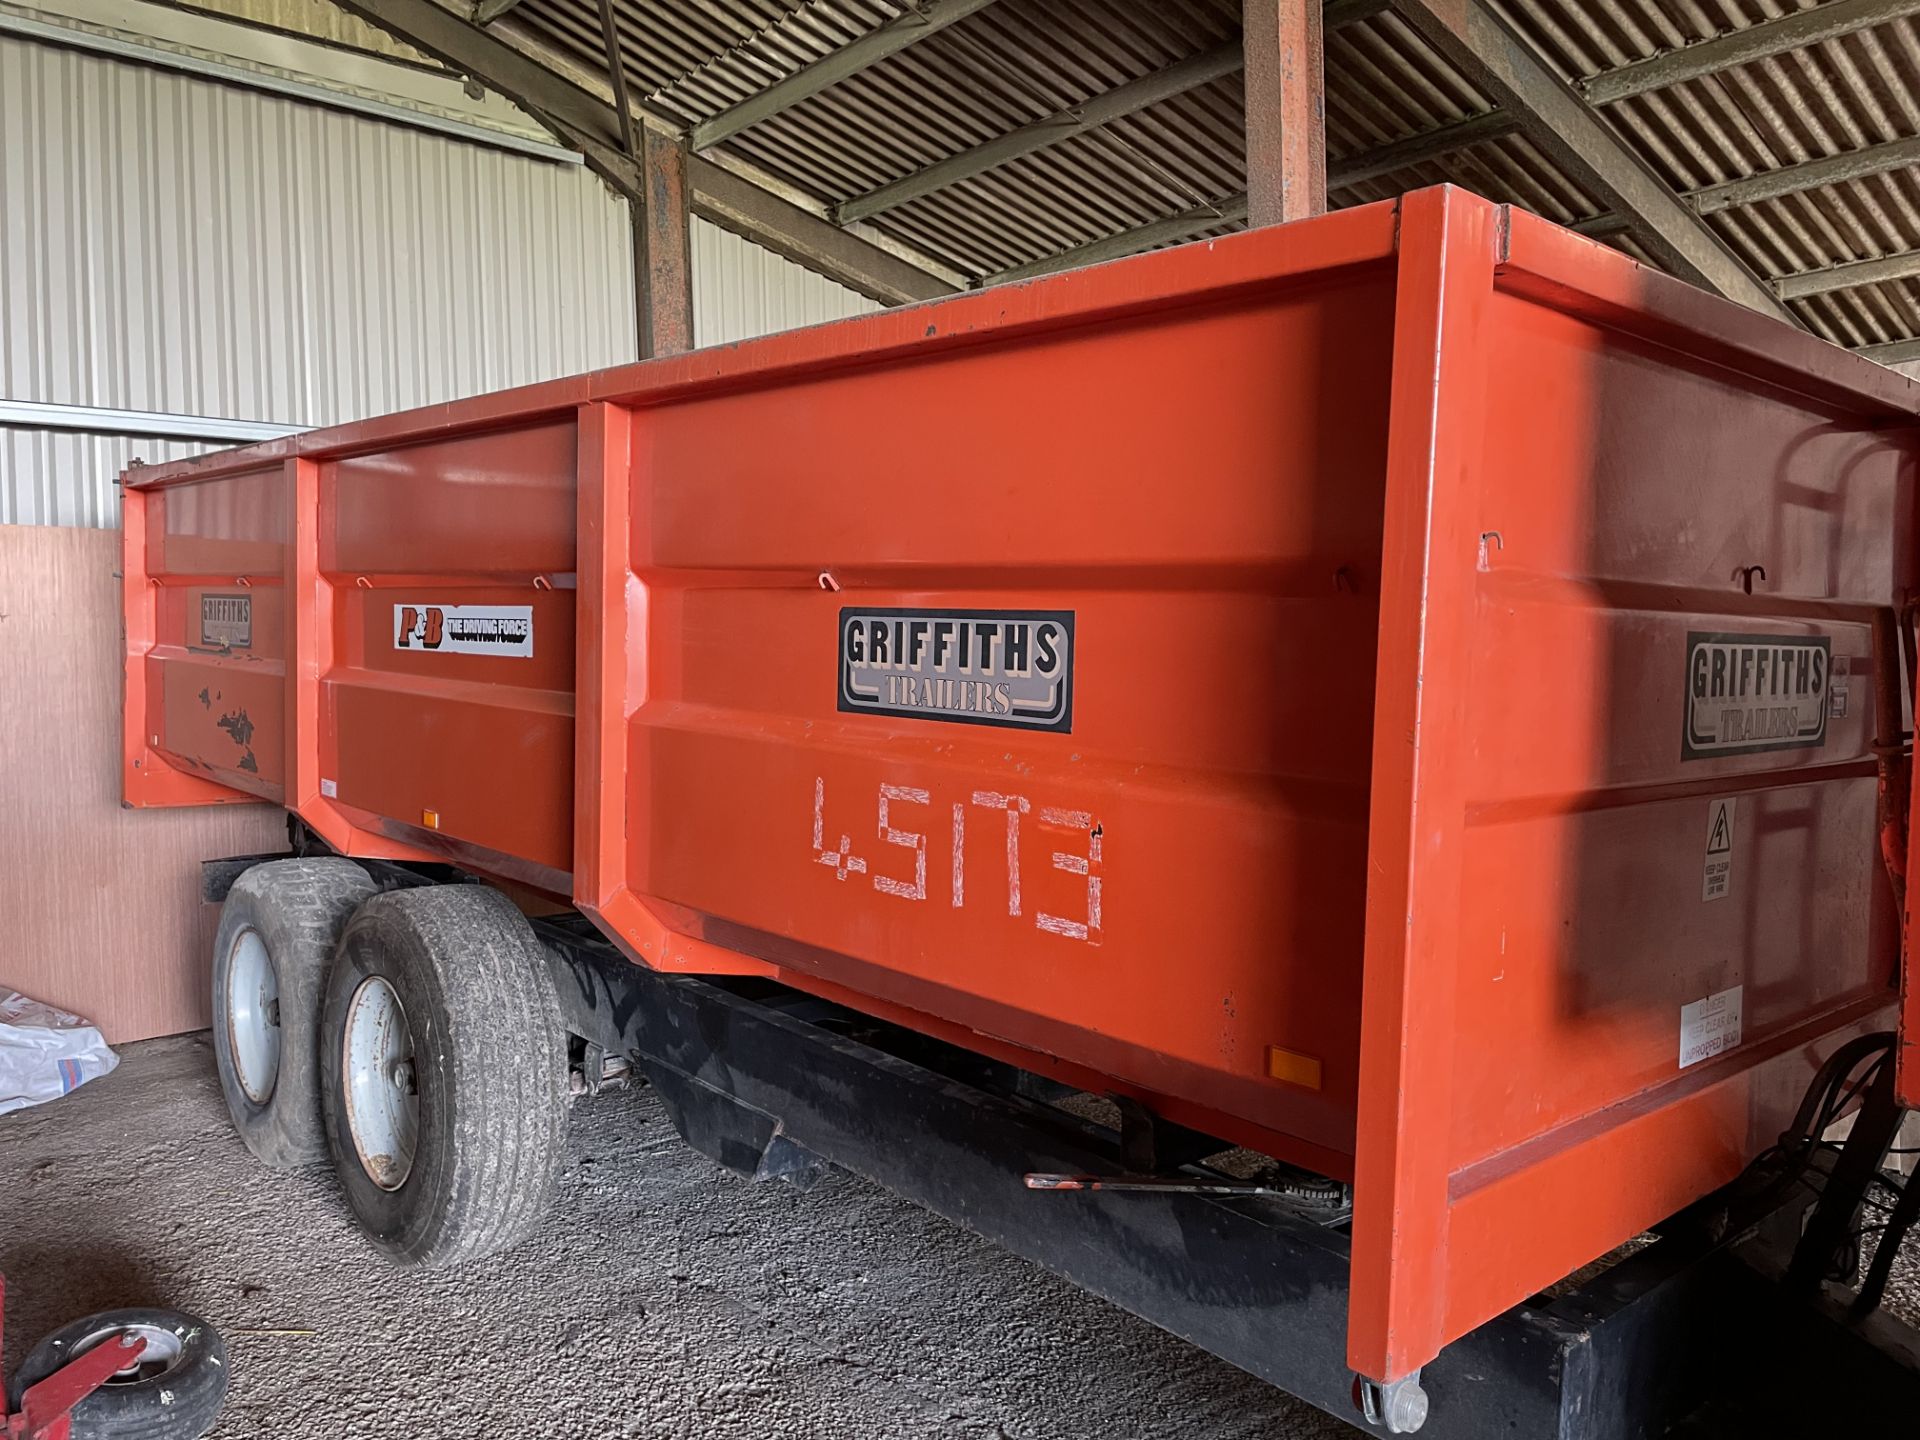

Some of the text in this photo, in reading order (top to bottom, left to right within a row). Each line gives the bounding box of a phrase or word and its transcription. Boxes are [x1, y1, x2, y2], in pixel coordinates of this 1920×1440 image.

[204, 599, 249, 622] GRIFFITHS
[398, 607, 444, 649] P&B
[447, 618, 529, 642] THE DRIVING FORCE
[846, 620, 1063, 679] GRIFFITHS
[884, 674, 1012, 716] TRAILERS
[1692, 648, 1824, 702] GRIFFITHS
[1720, 706, 1799, 743] TRAILERS
